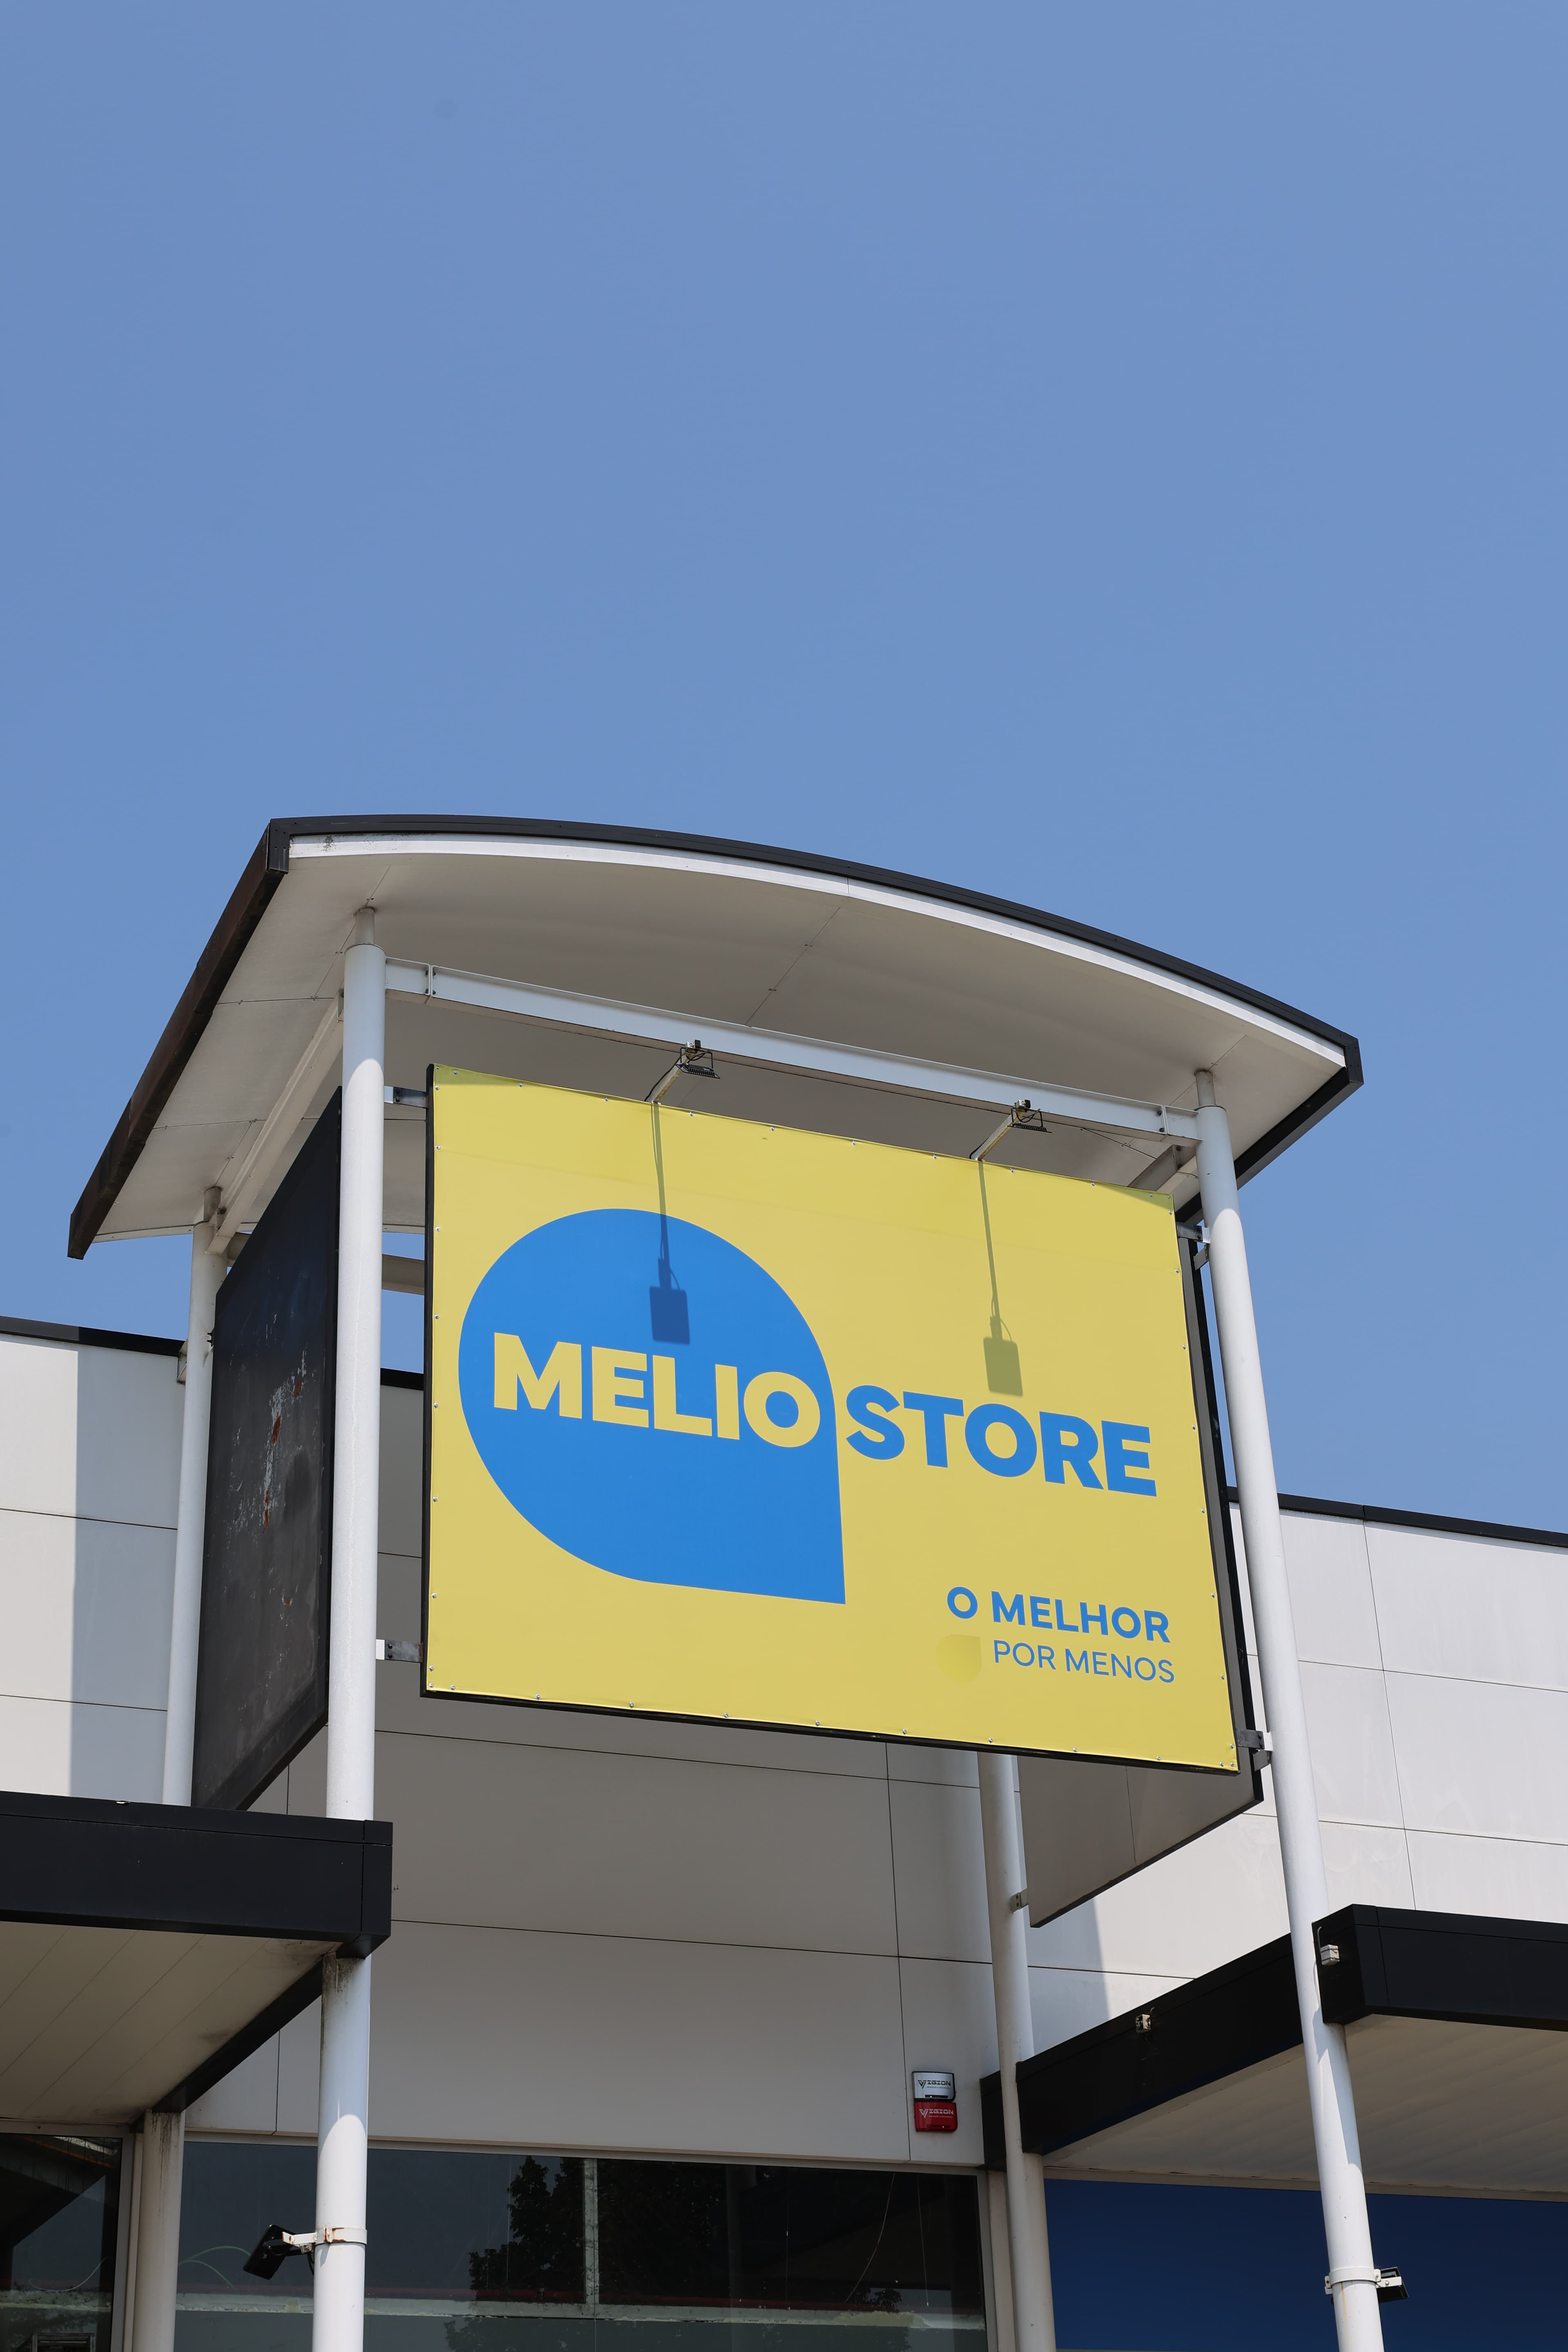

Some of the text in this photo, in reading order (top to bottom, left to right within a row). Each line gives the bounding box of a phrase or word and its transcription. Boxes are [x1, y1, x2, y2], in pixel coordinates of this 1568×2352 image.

[494, 1332, 1157, 1497] MELIO STORE
[947, 1586, 1170, 1643] O MELHOR
[993, 1639, 1174, 1683] POR MENOS
[918, 2080, 951, 2089] VIGION
[919, 2109, 954, 2118] VIGION
